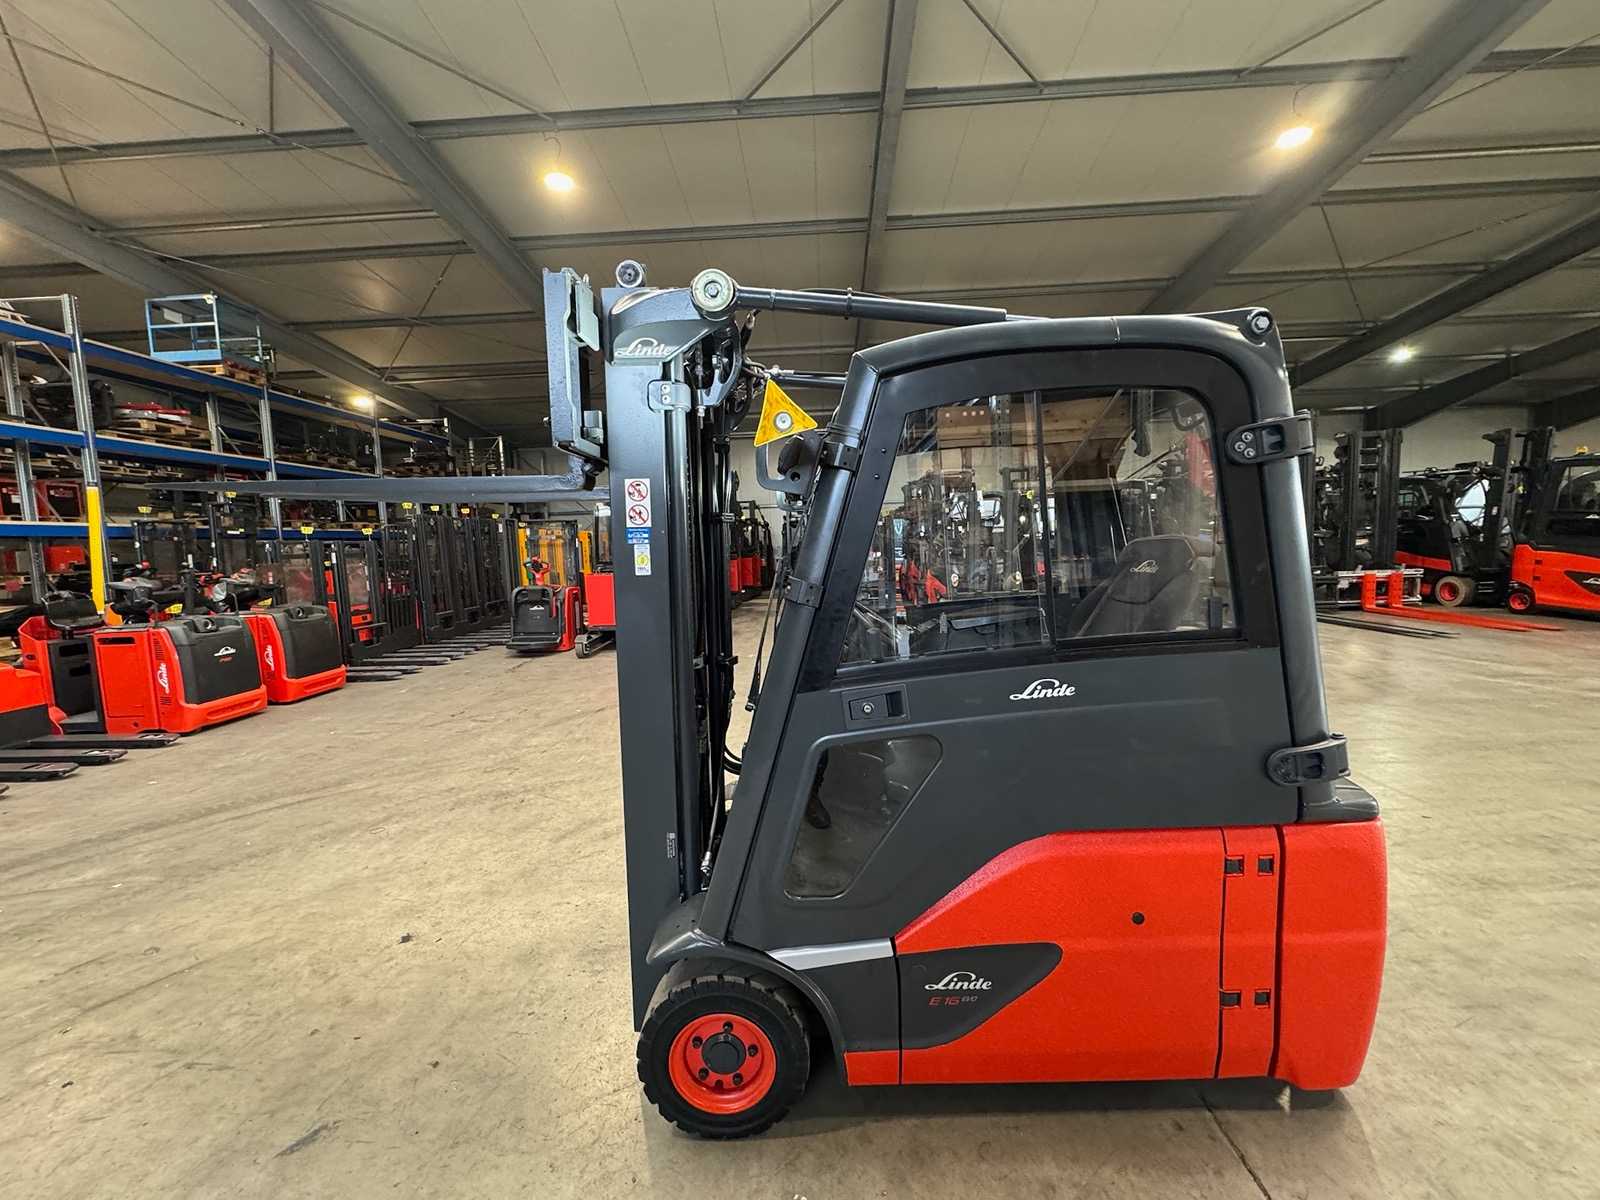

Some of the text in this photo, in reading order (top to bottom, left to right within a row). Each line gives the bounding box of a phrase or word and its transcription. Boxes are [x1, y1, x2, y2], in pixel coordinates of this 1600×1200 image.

[614, 337, 674, 357] Linde
[1009, 678, 1076, 701] Linde
[924, 971, 992, 990] Linde
